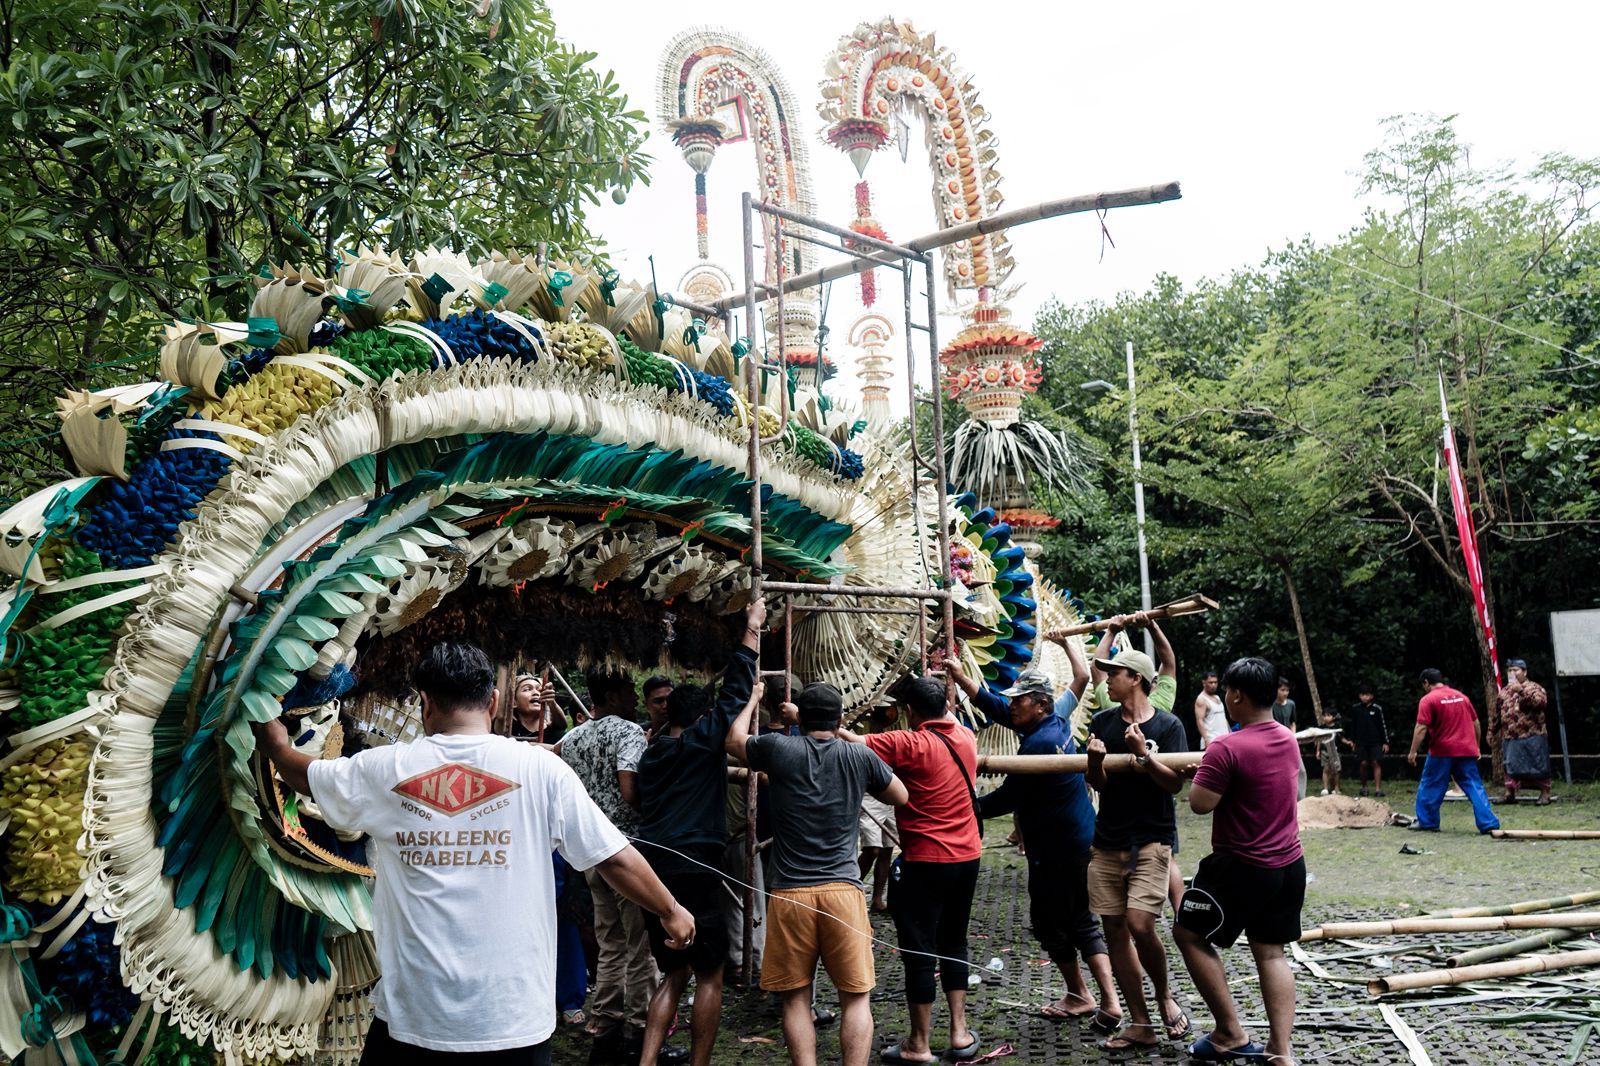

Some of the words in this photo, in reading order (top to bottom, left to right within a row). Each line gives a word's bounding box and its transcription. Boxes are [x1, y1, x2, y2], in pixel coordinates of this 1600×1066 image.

[421, 768, 487, 808] NK13
[400, 800, 433, 821] MOTOR
[470, 798, 511, 821] SYCLES
[396, 830, 511, 846] NASKLEENG
[400, 850, 507, 866] TIGABELAS
